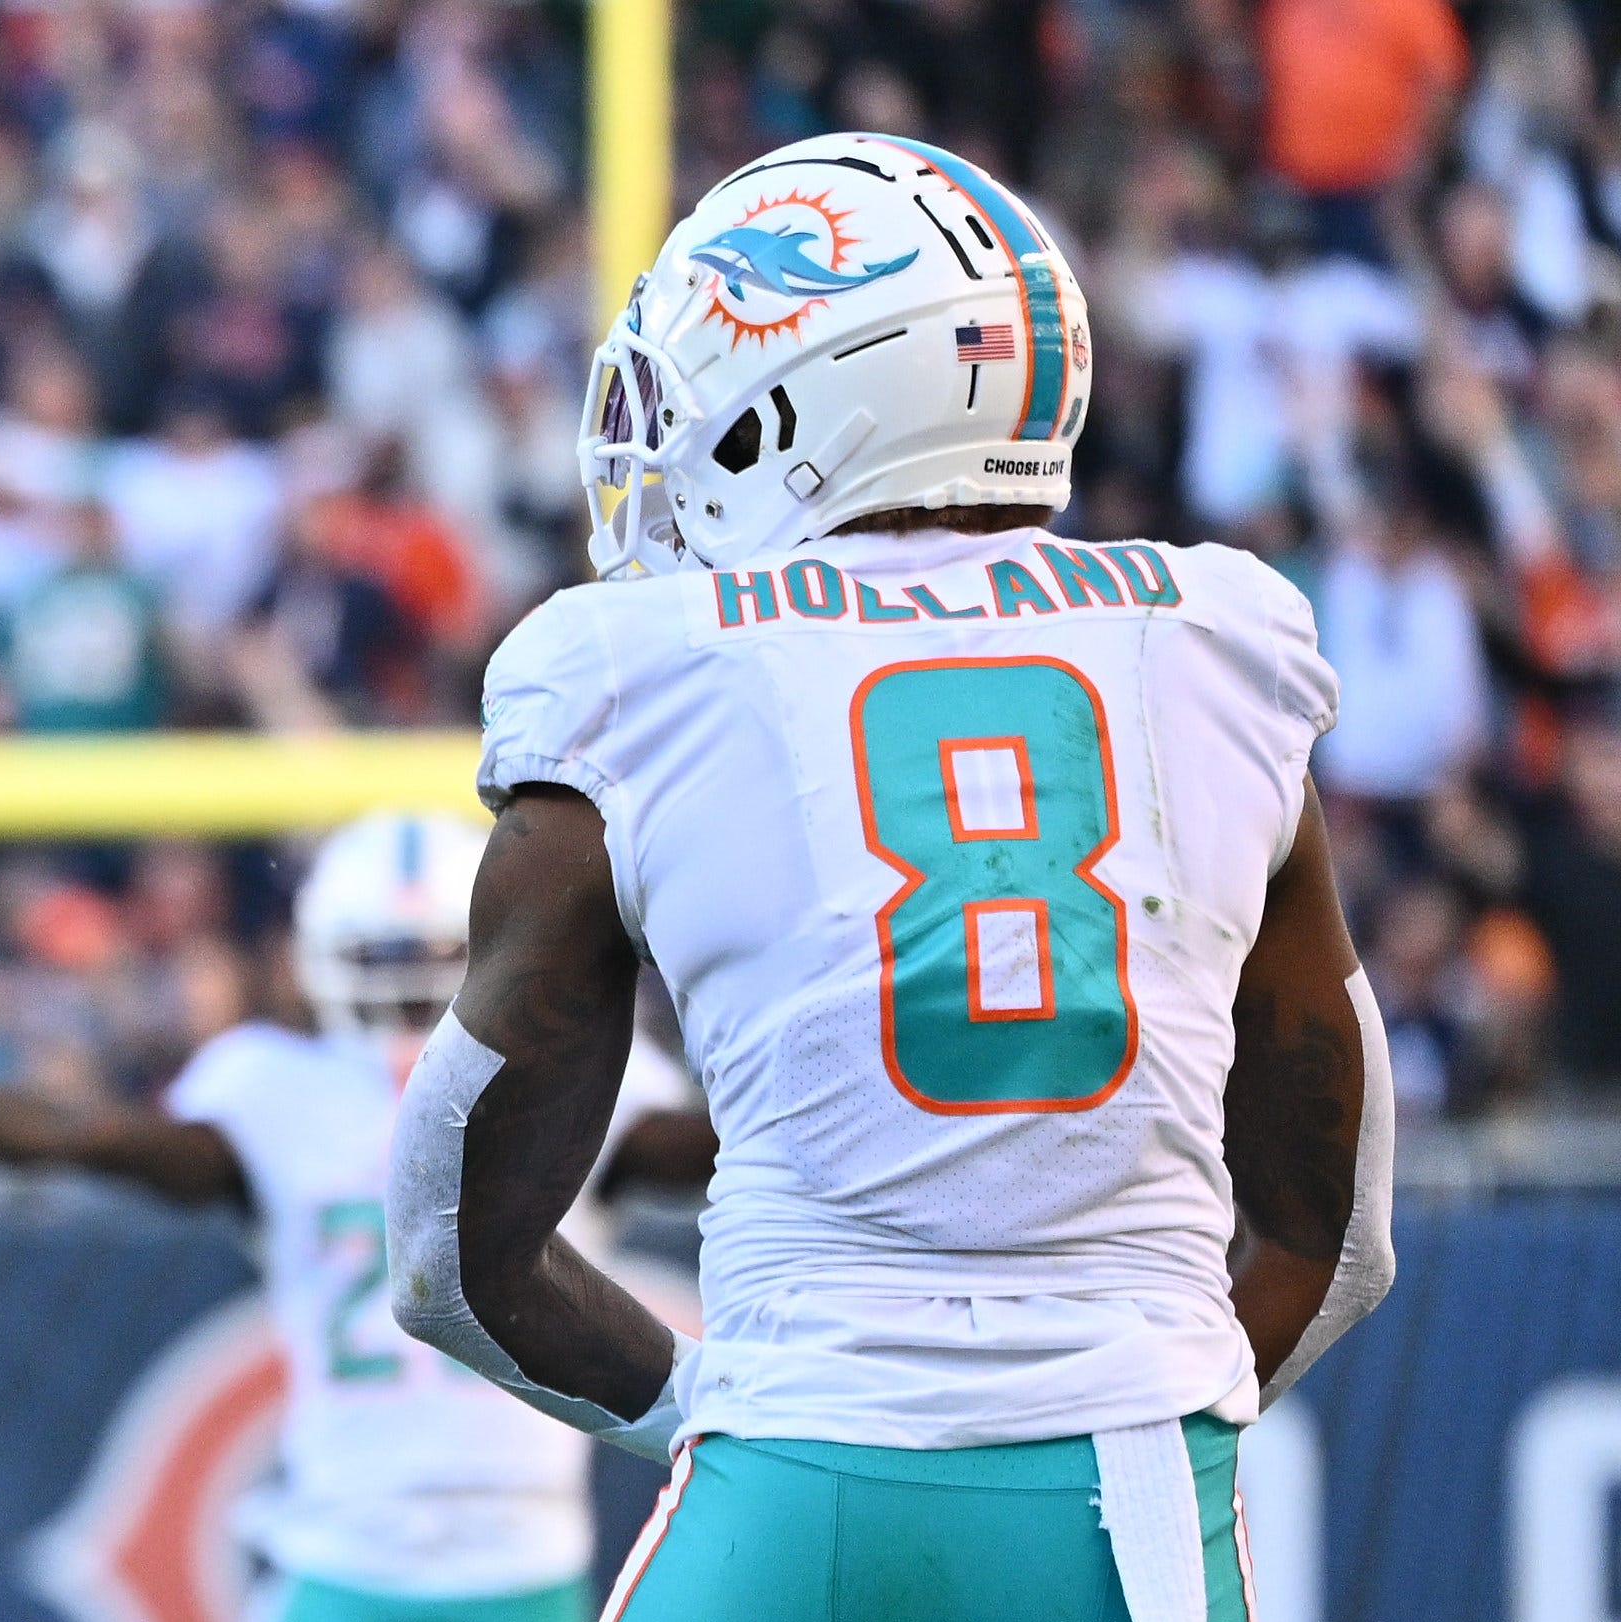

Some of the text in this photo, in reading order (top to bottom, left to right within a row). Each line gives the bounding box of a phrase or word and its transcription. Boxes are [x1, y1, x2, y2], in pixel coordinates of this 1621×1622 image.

[984, 458, 1040, 476] CHOOSE
[711, 542, 1184, 631] HOLLAND
[848, 654, 1139, 1117] 8
